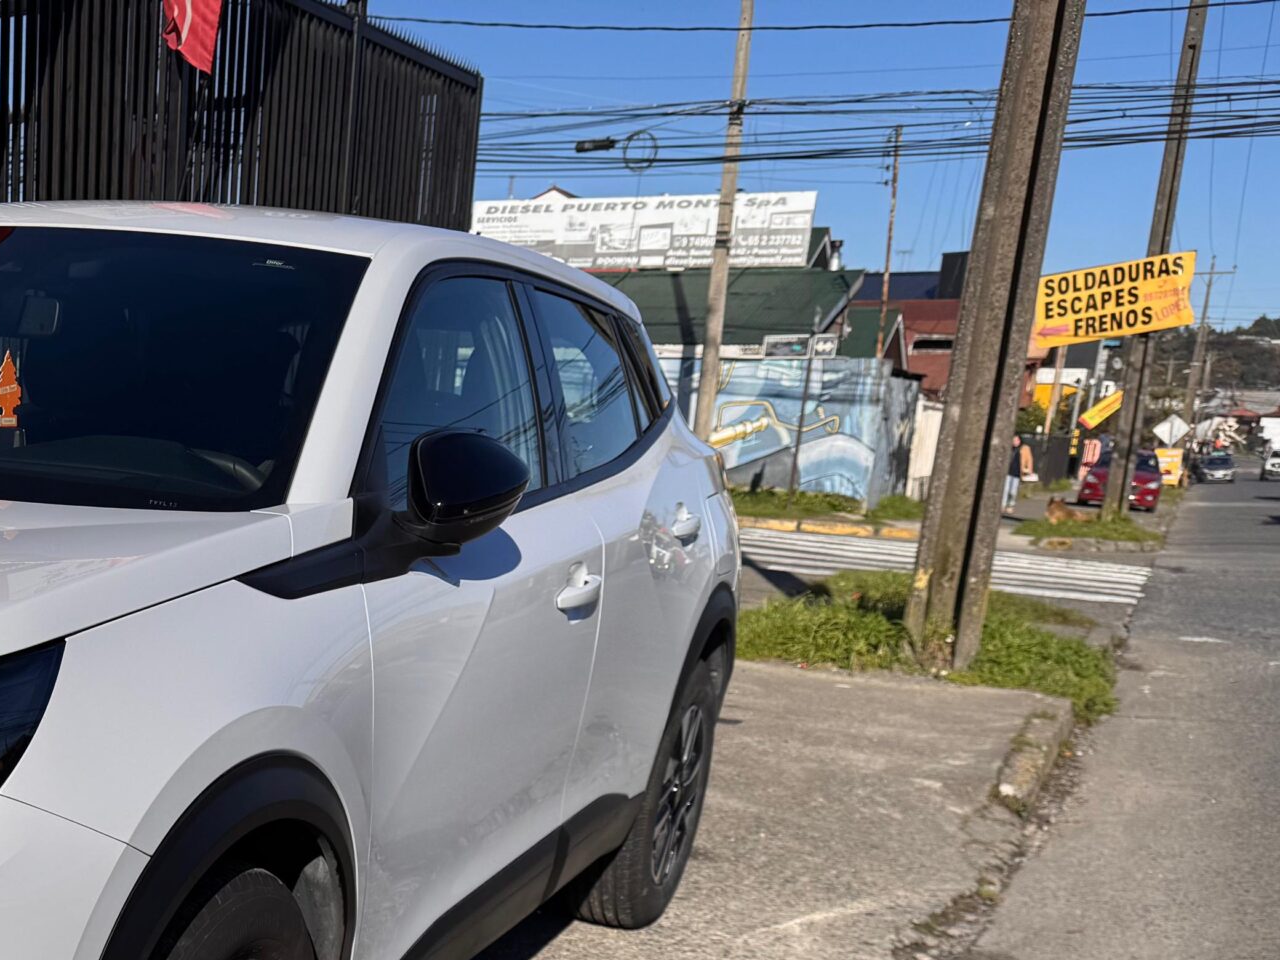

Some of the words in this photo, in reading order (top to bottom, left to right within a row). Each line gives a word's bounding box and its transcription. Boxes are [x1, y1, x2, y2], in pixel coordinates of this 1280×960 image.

[486, 203, 554, 215] DIESEL
[561, 201, 648, 213] PUERTO
[1044, 256, 1184, 298] SOLDADURAS
[1045, 286, 1139, 320] ESCAPES
[1074, 306, 1152, 337] FRENOS
